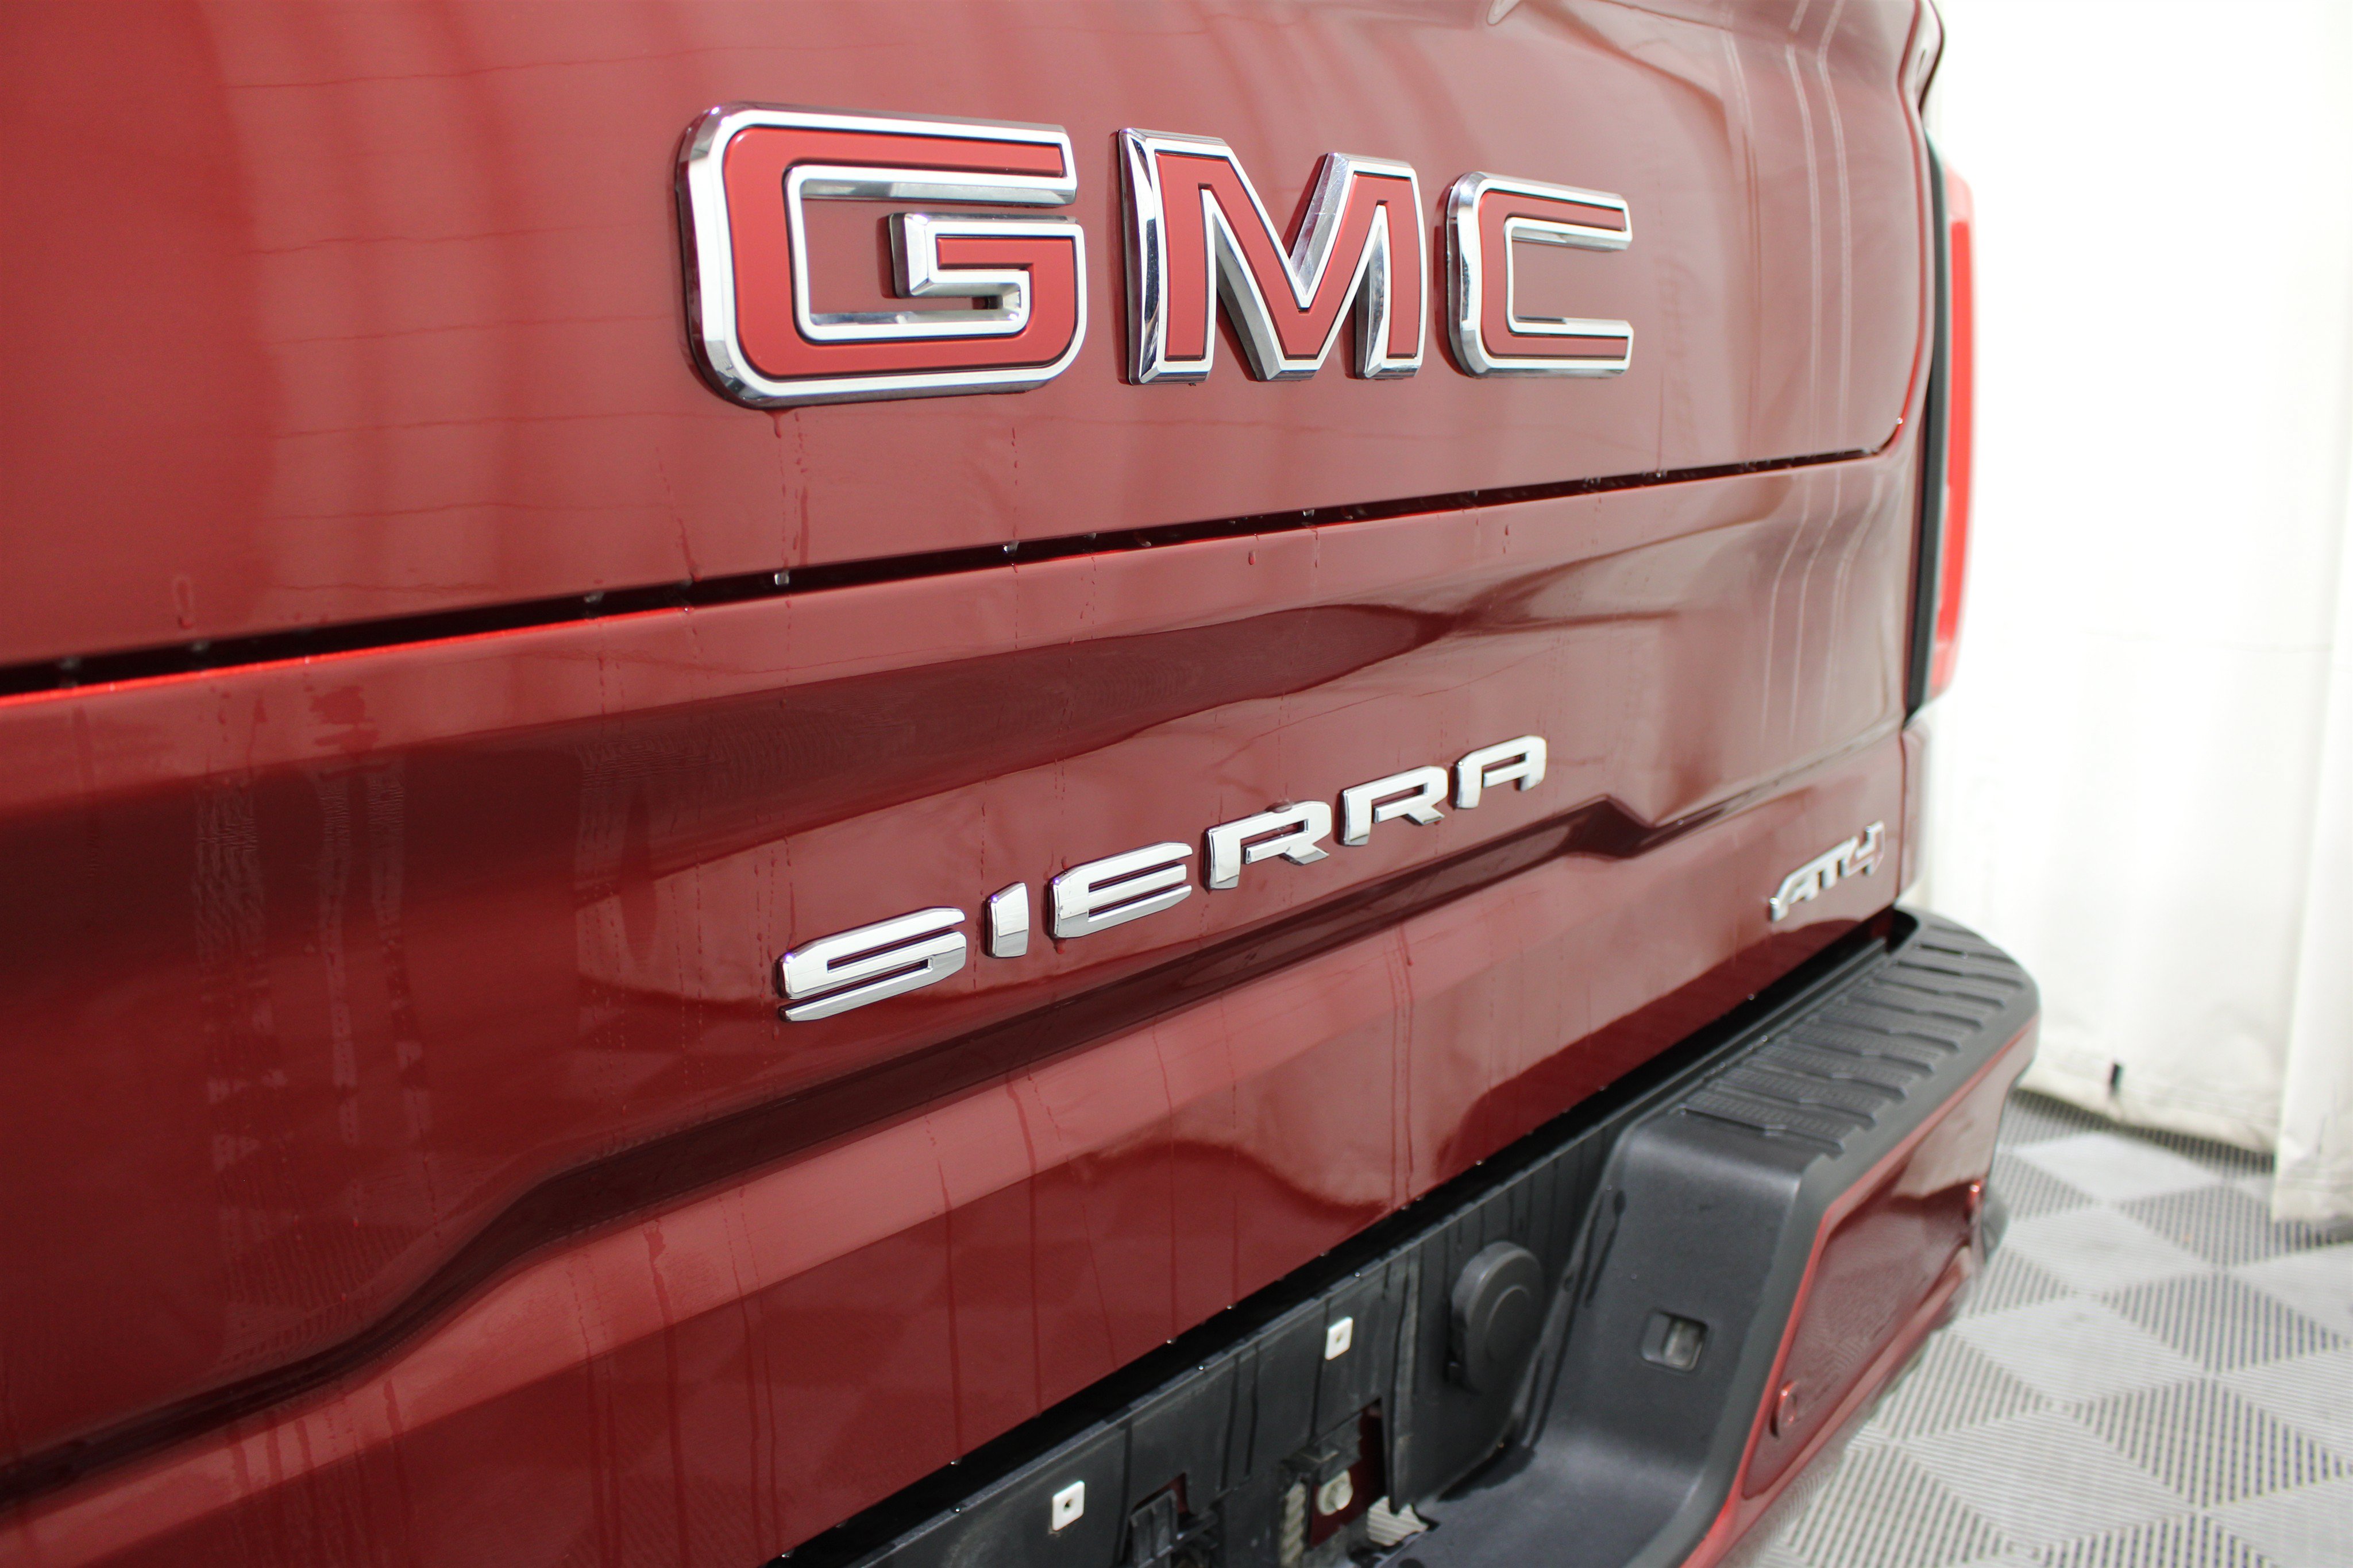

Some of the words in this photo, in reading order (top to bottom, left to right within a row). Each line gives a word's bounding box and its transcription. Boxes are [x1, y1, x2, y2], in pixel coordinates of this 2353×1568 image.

[679, 102, 1633, 408] GMC
[778, 735, 1547, 1022] SIERRA
[1769, 820, 1885, 922] AT4
